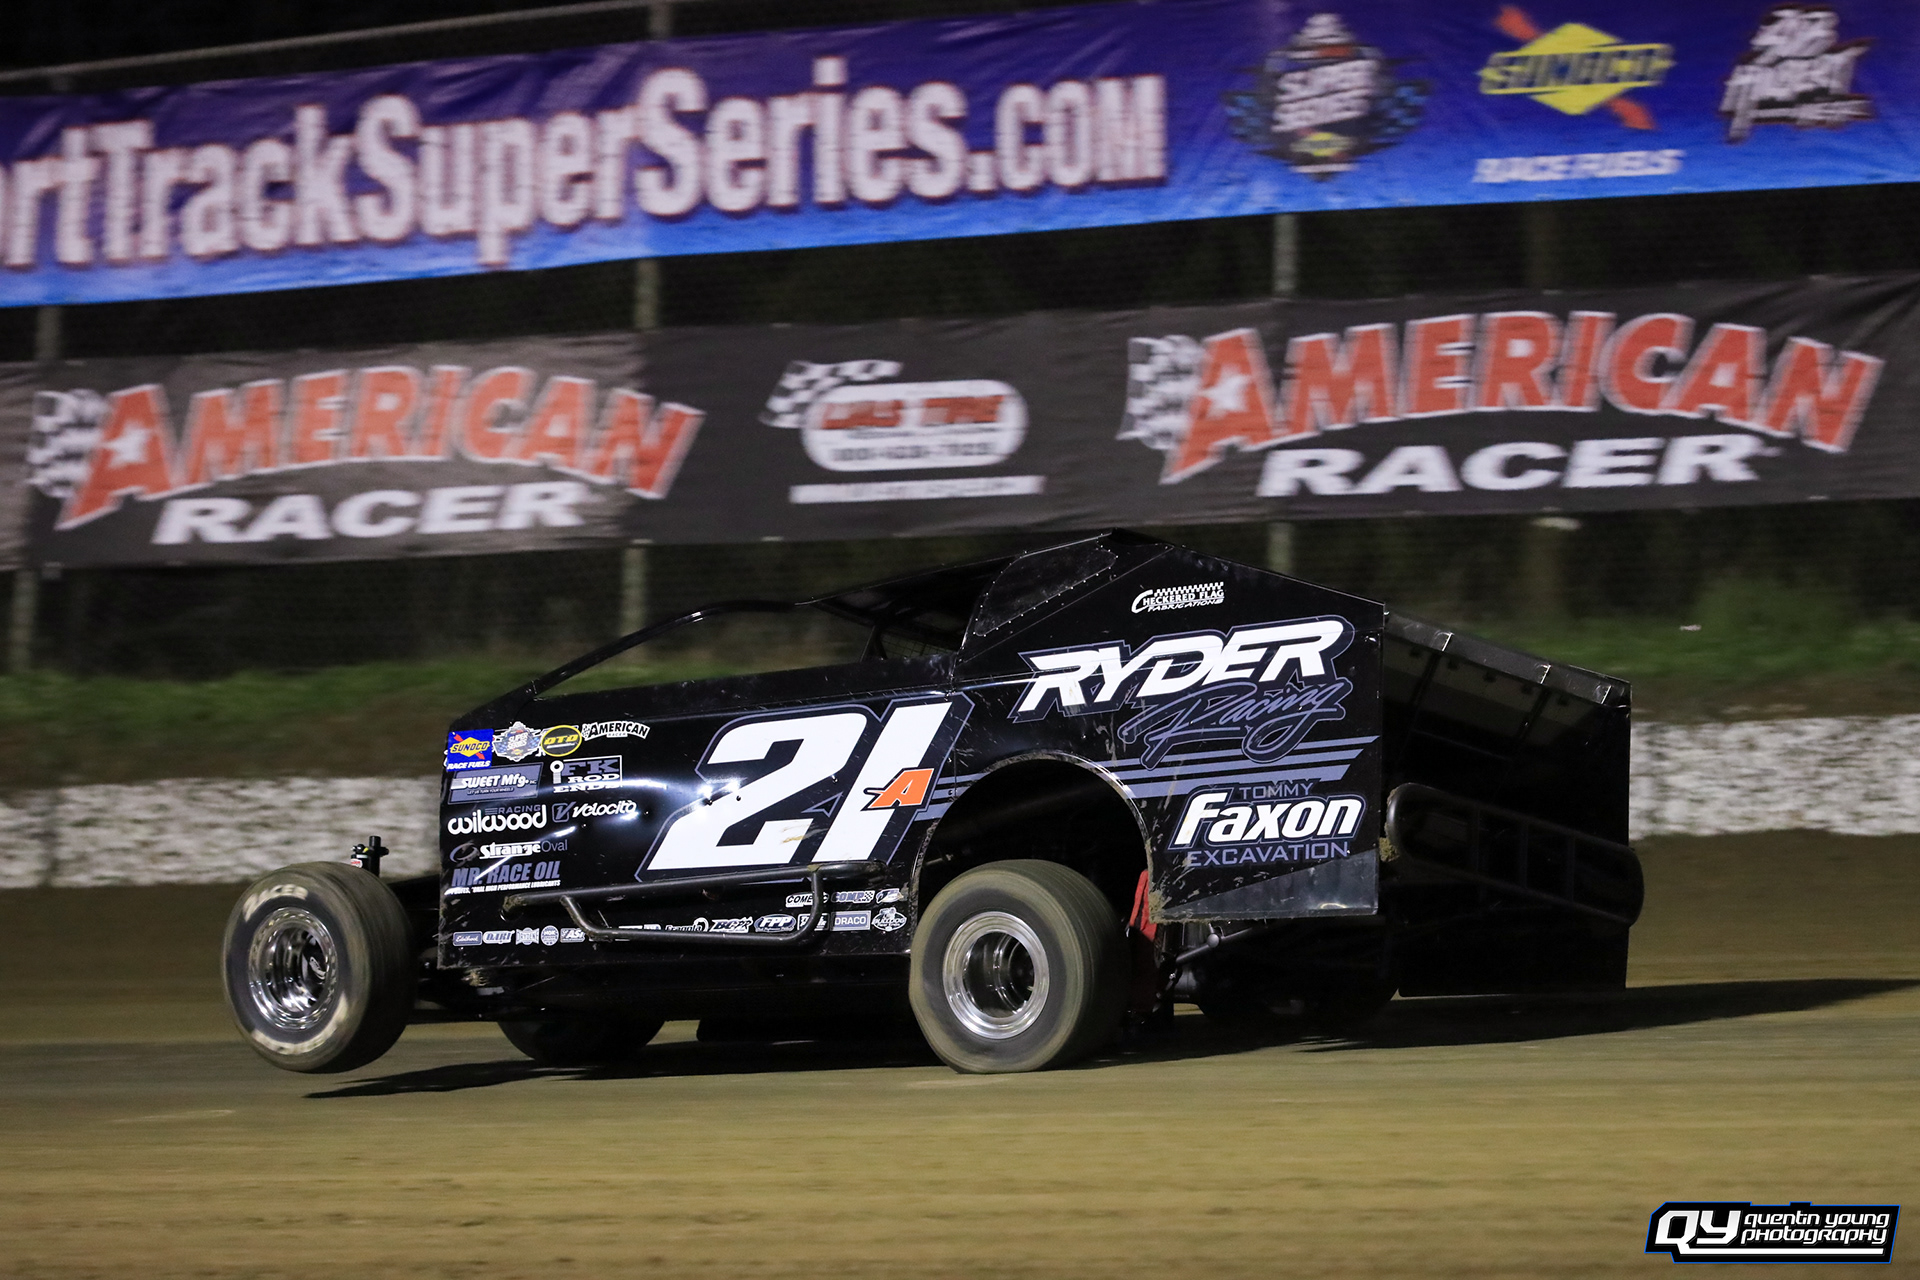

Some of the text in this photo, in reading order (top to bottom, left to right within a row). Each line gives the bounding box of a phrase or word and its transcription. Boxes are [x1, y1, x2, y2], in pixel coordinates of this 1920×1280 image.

[1160, 310, 1885, 485] AMERICAN
[55, 365, 706, 529] AMERICAN
[1256, 433, 1758, 496] RACER
[152, 481, 587, 544] RACER
[1131, 589, 1224, 613] CHECKERED FLAG
[1018, 620, 1344, 712] RYDER
[587, 722, 649, 738] AMERICAN
[1120, 681, 1351, 768] Racing
[452, 742, 489, 752] SUNOCO
[447, 760, 491, 770] RACE FUELS
[561, 759, 620, 776] FK
[451, 775, 500, 790] SWEET
[568, 773, 620, 783] ROD
[645, 700, 955, 870] 21
[866, 768, 934, 809] A
[1239, 782, 1313, 800] TOMMY
[447, 804, 547, 836] wilwood
[498, 804, 541, 814] RACING
[1174, 792, 1362, 845] Faxon
[541, 839, 568, 852] Oval
[1188, 841, 1349, 867] EXCAVATION
[452, 860, 561, 887] MR. RACE OIL
[759, 916, 793, 928] FPP
[834, 917, 866, 926] DRACO
